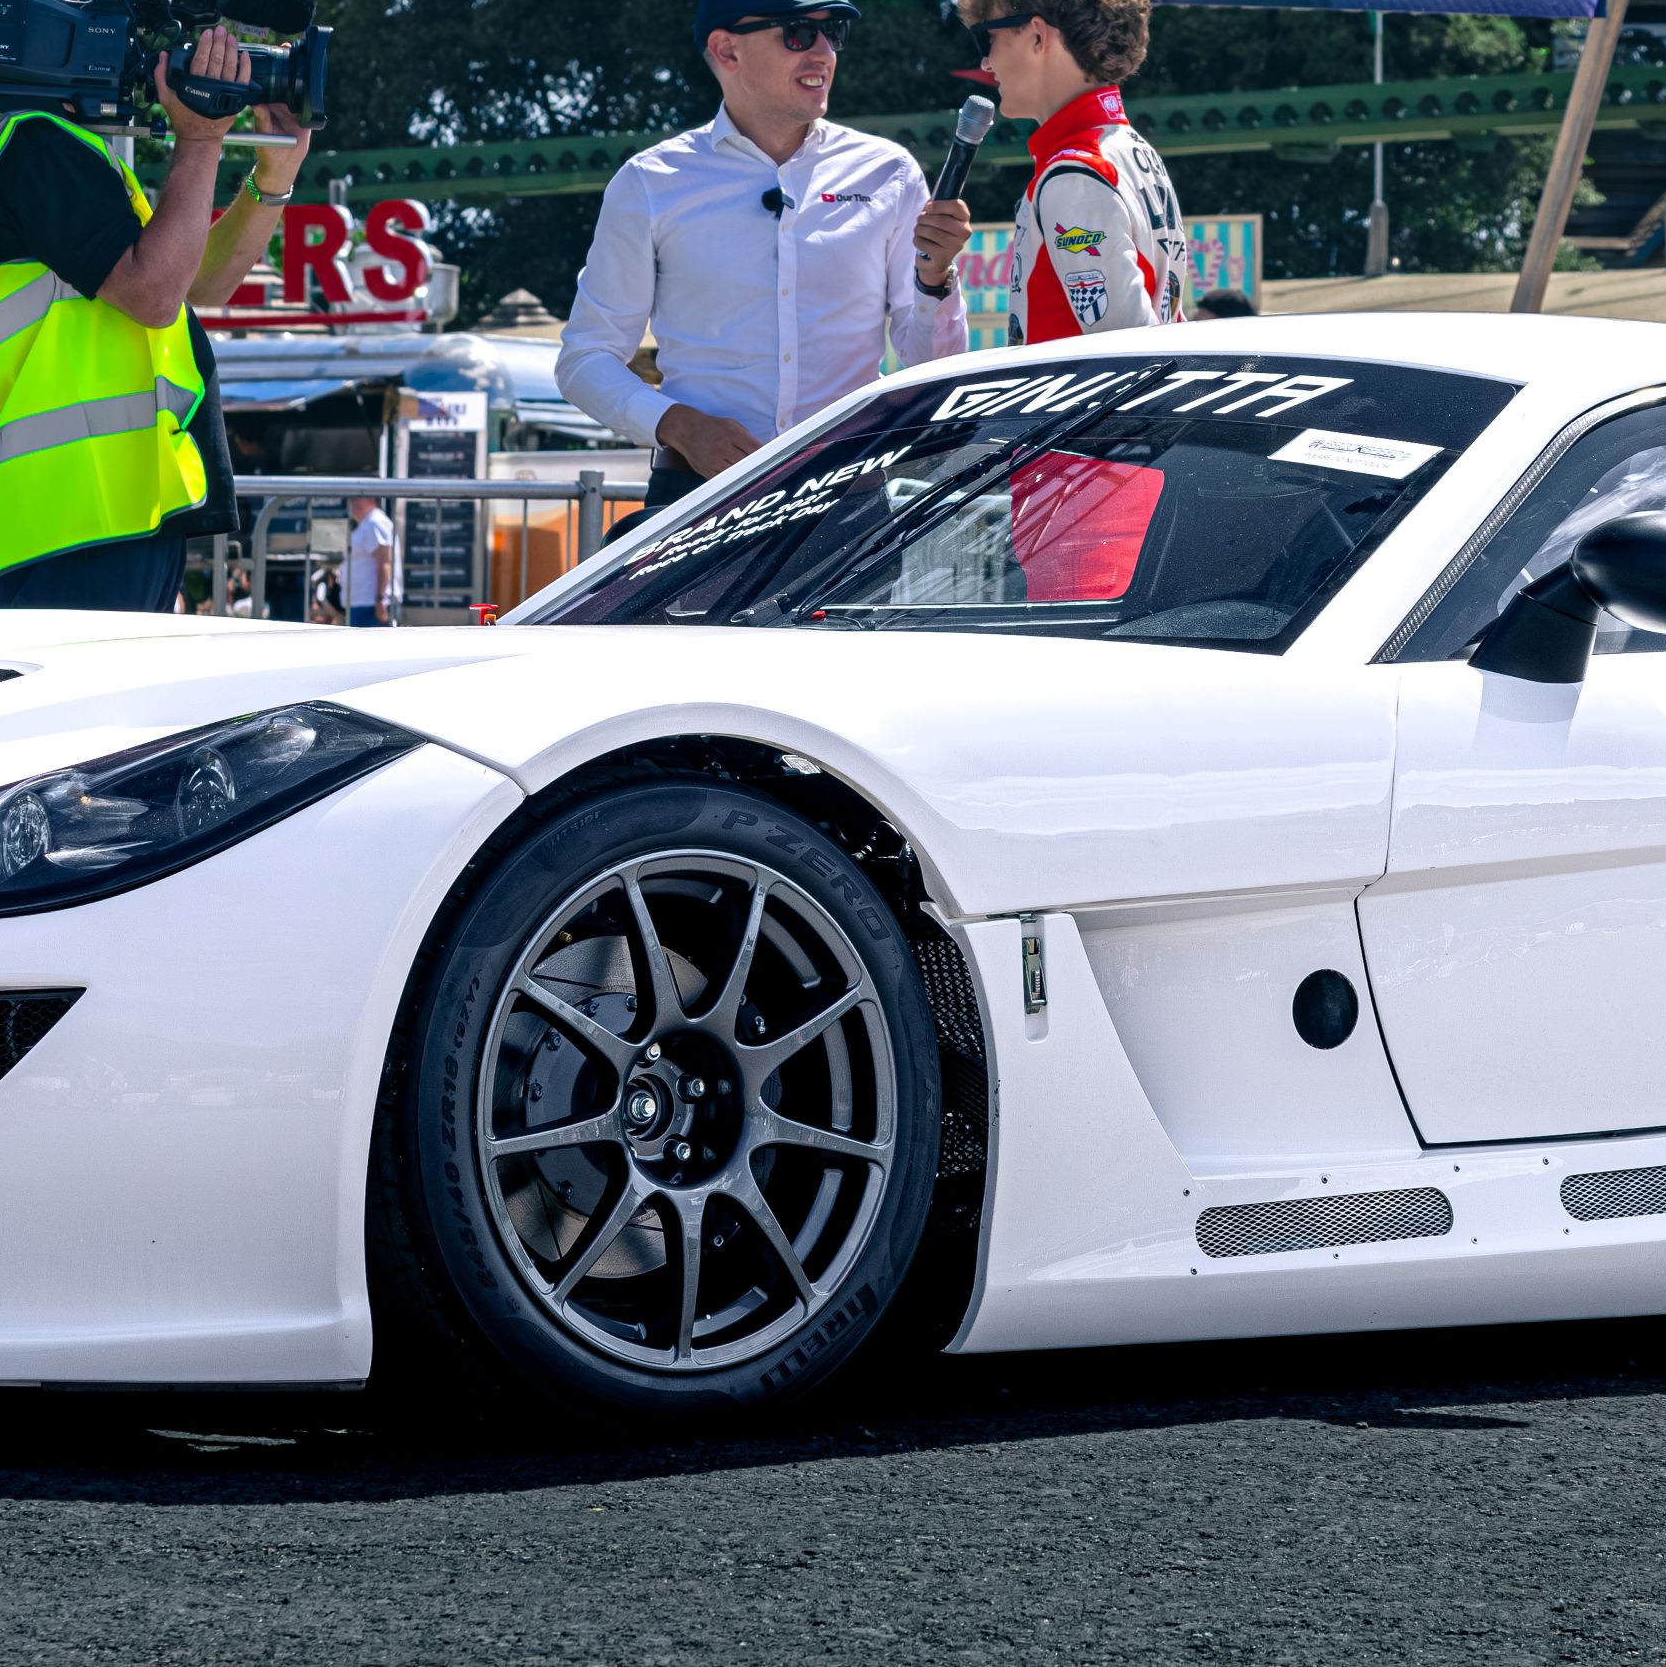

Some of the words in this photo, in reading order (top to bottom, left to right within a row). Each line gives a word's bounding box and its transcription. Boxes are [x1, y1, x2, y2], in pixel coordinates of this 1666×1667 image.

[87, 25, 117, 35] SONY
[184, 84, 212, 100] Canon
[836, 194, 853, 202] Our
[1056, 230, 1103, 249] SUNOCO
[930, 371, 1355, 422] GINTTA
[623, 490, 787, 567] BRAND
[793, 445, 912, 498] NEW
[628, 552, 689, 581] Race
[788, 498, 841, 522] Day
[658, 524, 734, 560] Ready
[758, 1283, 879, 1394] PIRELLI
